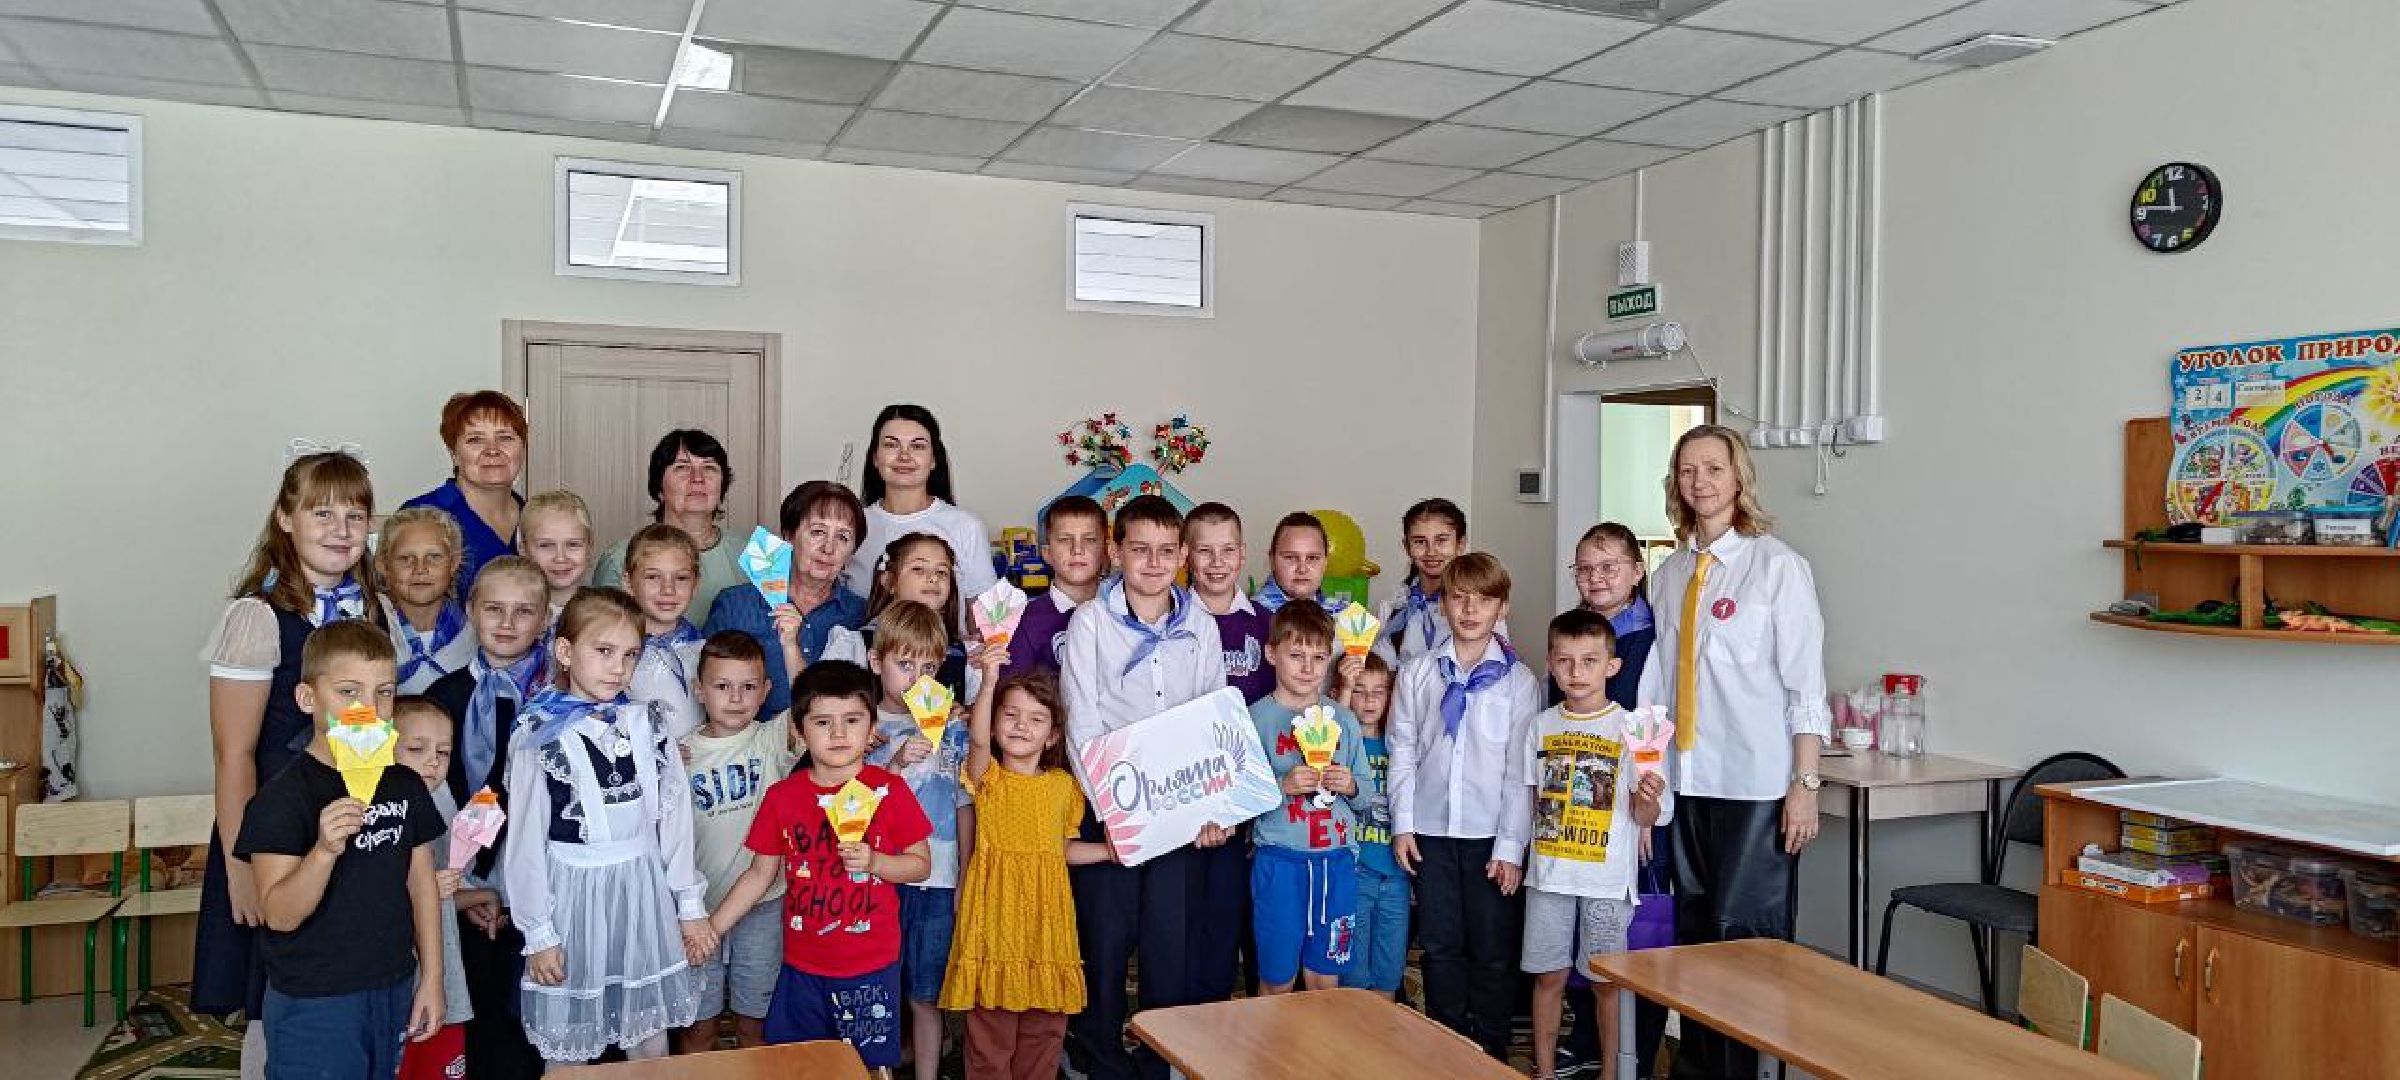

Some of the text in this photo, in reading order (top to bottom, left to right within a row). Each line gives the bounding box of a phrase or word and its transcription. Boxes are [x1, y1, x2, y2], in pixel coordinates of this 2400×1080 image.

[2165, 166, 2184, 180] 12
[2141, 189, 2157, 203] 10
[2152, 233, 2162, 248] 7
[1609, 291, 1654, 314] ВЫХОД
[2179, 346, 2283, 371] УГОЛОК
[2194, 388, 2202, 401] 2
[1108, 754, 1228, 812] Орлята
[1564, 825, 1609, 848] WOOD
[788, 882, 879, 920] SCHOOL
[840, 984, 884, 1006] BACK
[837, 1019, 891, 1039] SCHOOL
